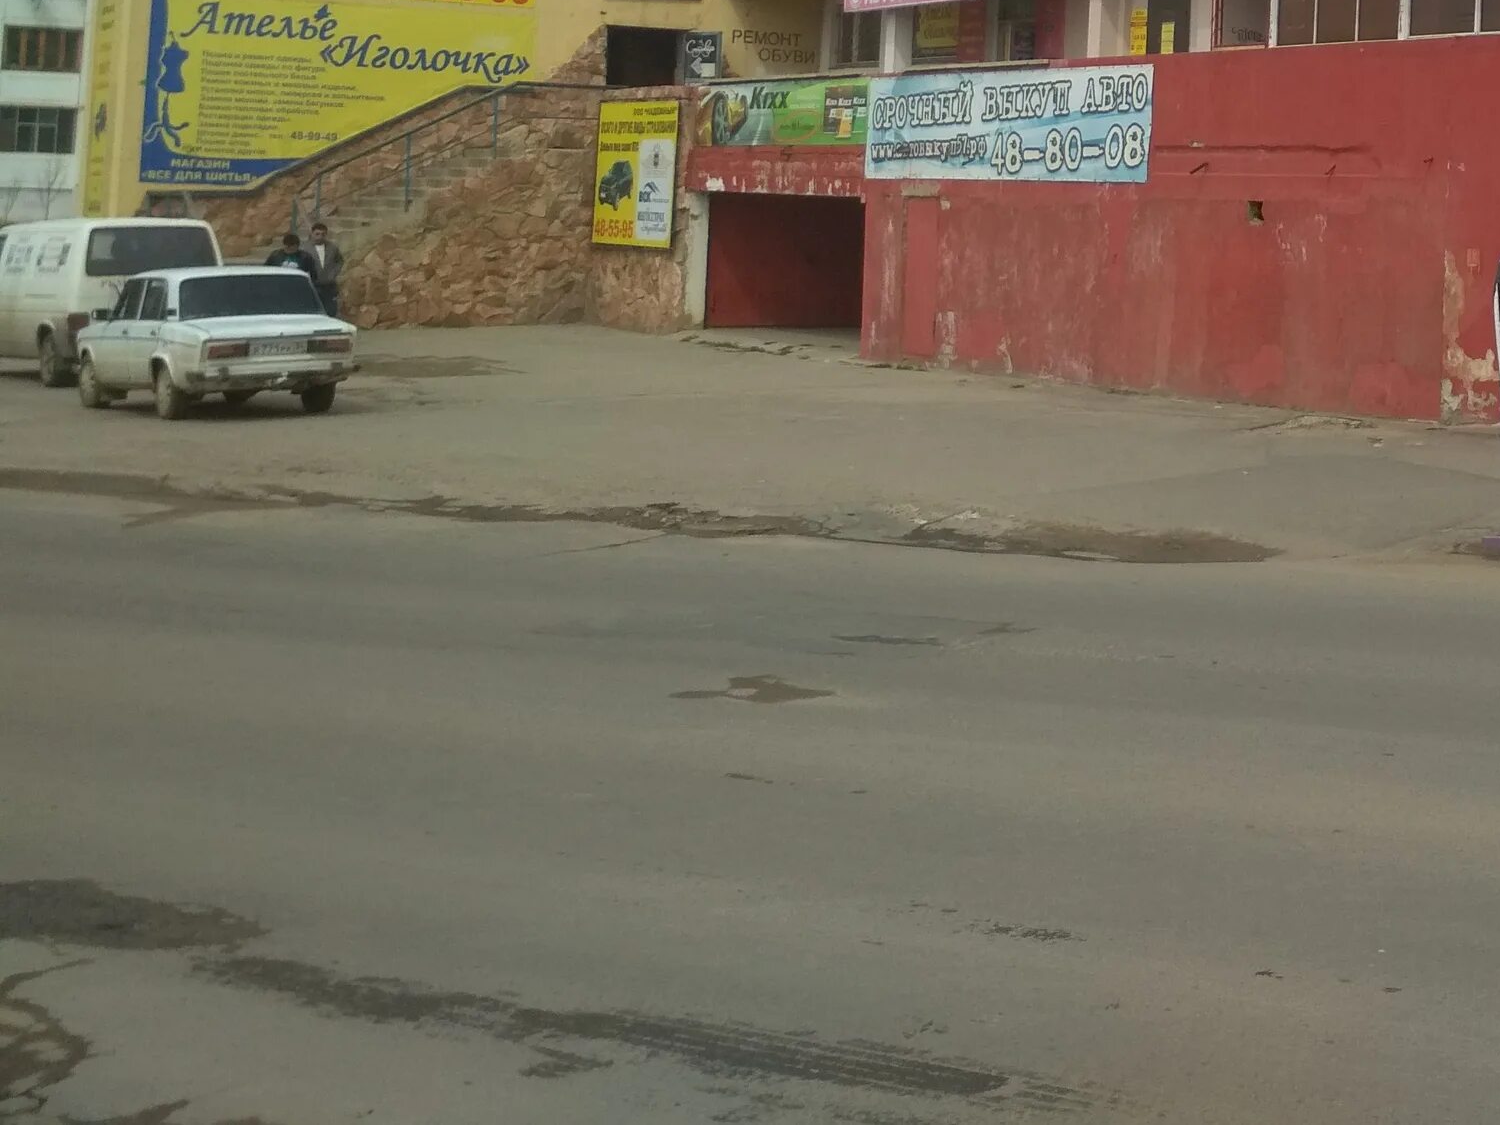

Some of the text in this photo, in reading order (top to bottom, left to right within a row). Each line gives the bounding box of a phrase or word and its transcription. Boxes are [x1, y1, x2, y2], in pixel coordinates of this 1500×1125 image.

[180, 1, 338, 41] Ателье
[732, 29, 803, 47] РЕМОНТ
[320, 34, 530, 84] «Иголочка»
[759, 48, 815, 63] ОБУВИ
[872, 79, 974, 130] СРОЧНЫЙ
[981, 79, 1072, 122] ВЫКУП
[1081, 73, 1149, 114] АВТО
[990, 123, 1145, 175] 48-80-08
[171, 158, 230, 169] МАГАЗИН
[175, 171, 202, 182] ДЛЯ
[595, 218, 634, 239] 48-55-95
